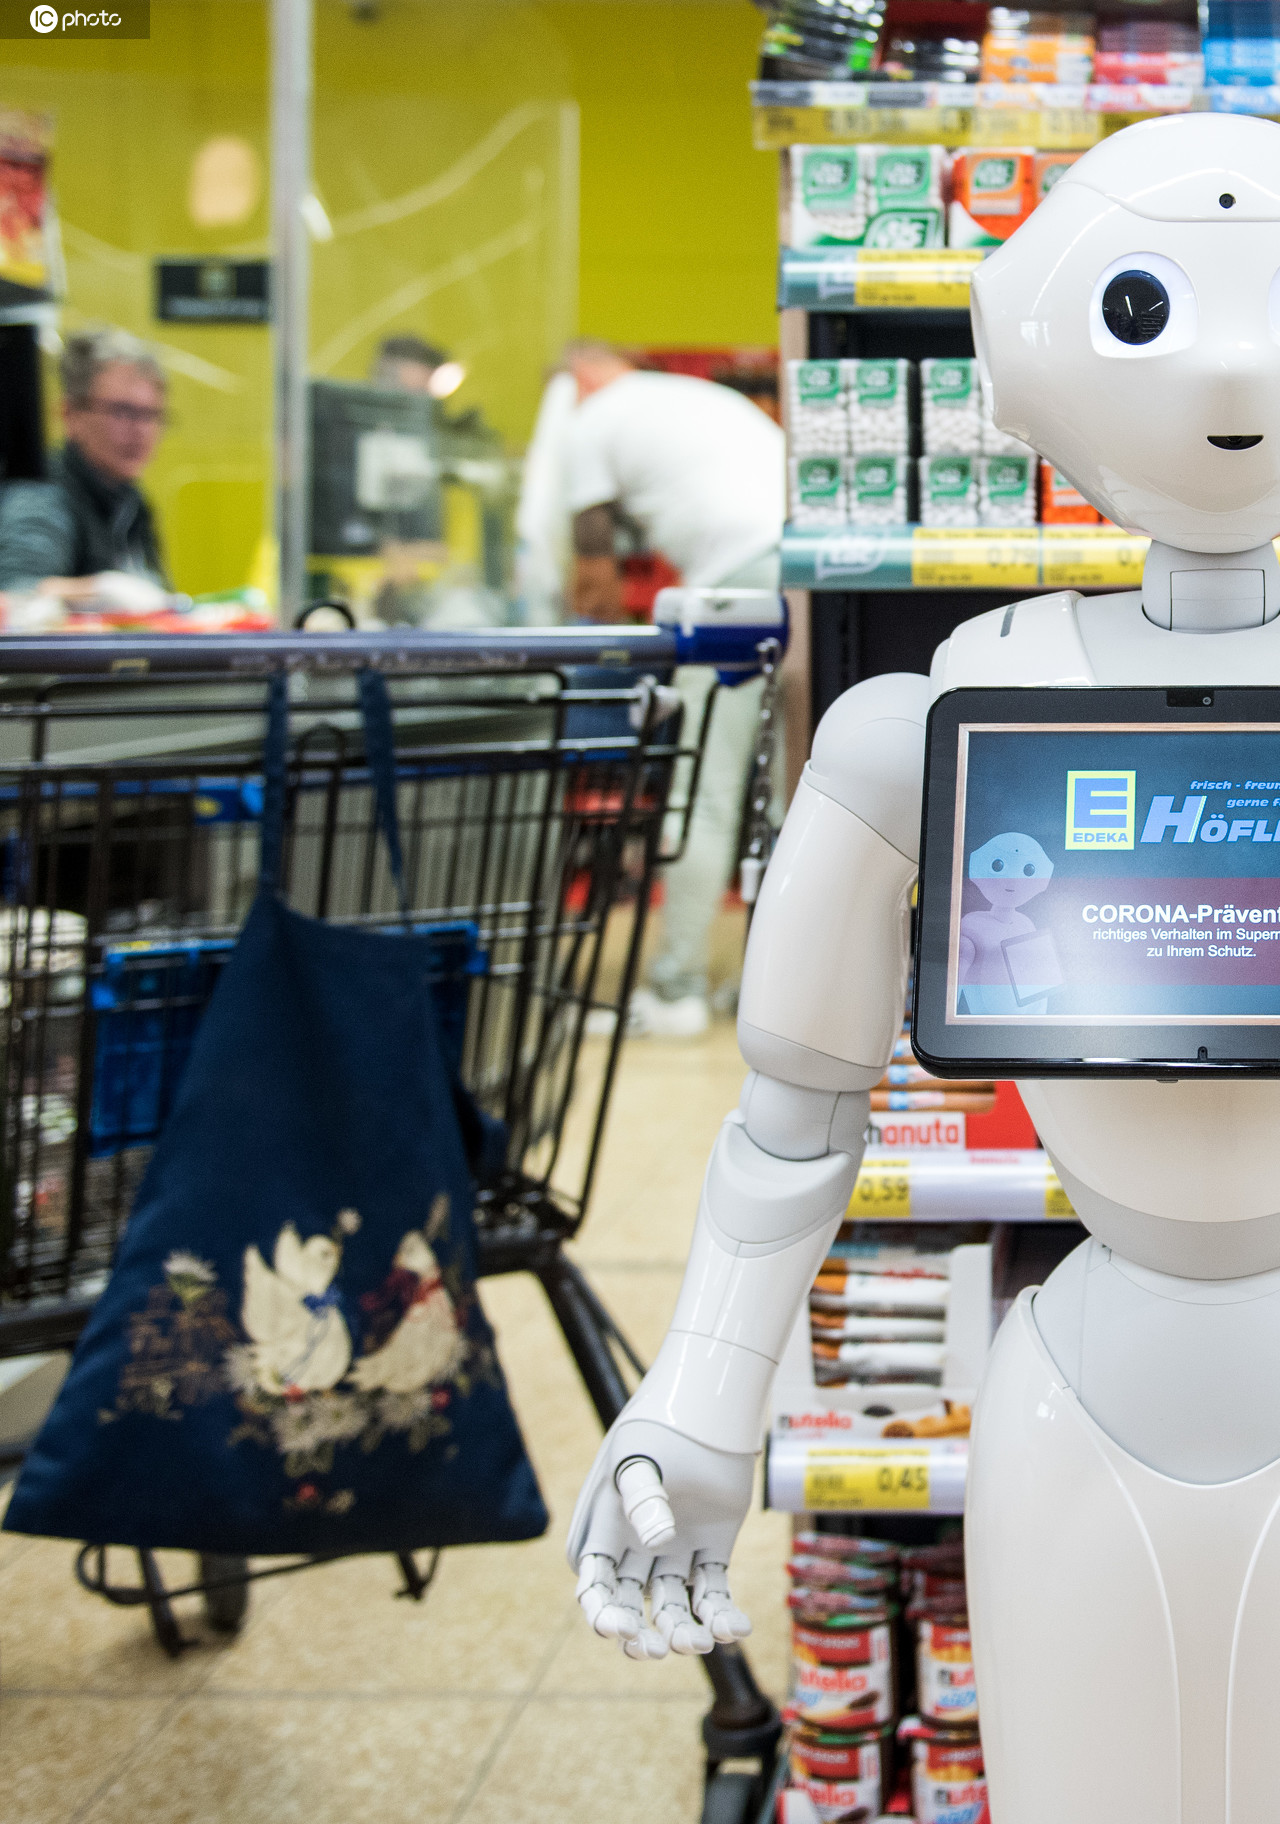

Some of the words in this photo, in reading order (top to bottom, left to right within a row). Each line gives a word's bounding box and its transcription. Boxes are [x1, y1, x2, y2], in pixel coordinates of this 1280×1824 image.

[1190, 780, 1232, 790] frisch
[1073, 778, 1128, 828] E
[1226, 798, 1269, 809] gerne
[1072, 832, 1129, 843] EDEKA
[1093, 928, 1148, 943] richtiges
[1151, 927, 1213, 941] Verhalten
[1216, 927, 1232, 940] im
[1146, 947, 1163, 957] zu
[1166, 945, 1205, 957] Ihrem
[1207, 945, 1257, 957] Schutz.
[867, 1119, 959, 1145] hanuta
